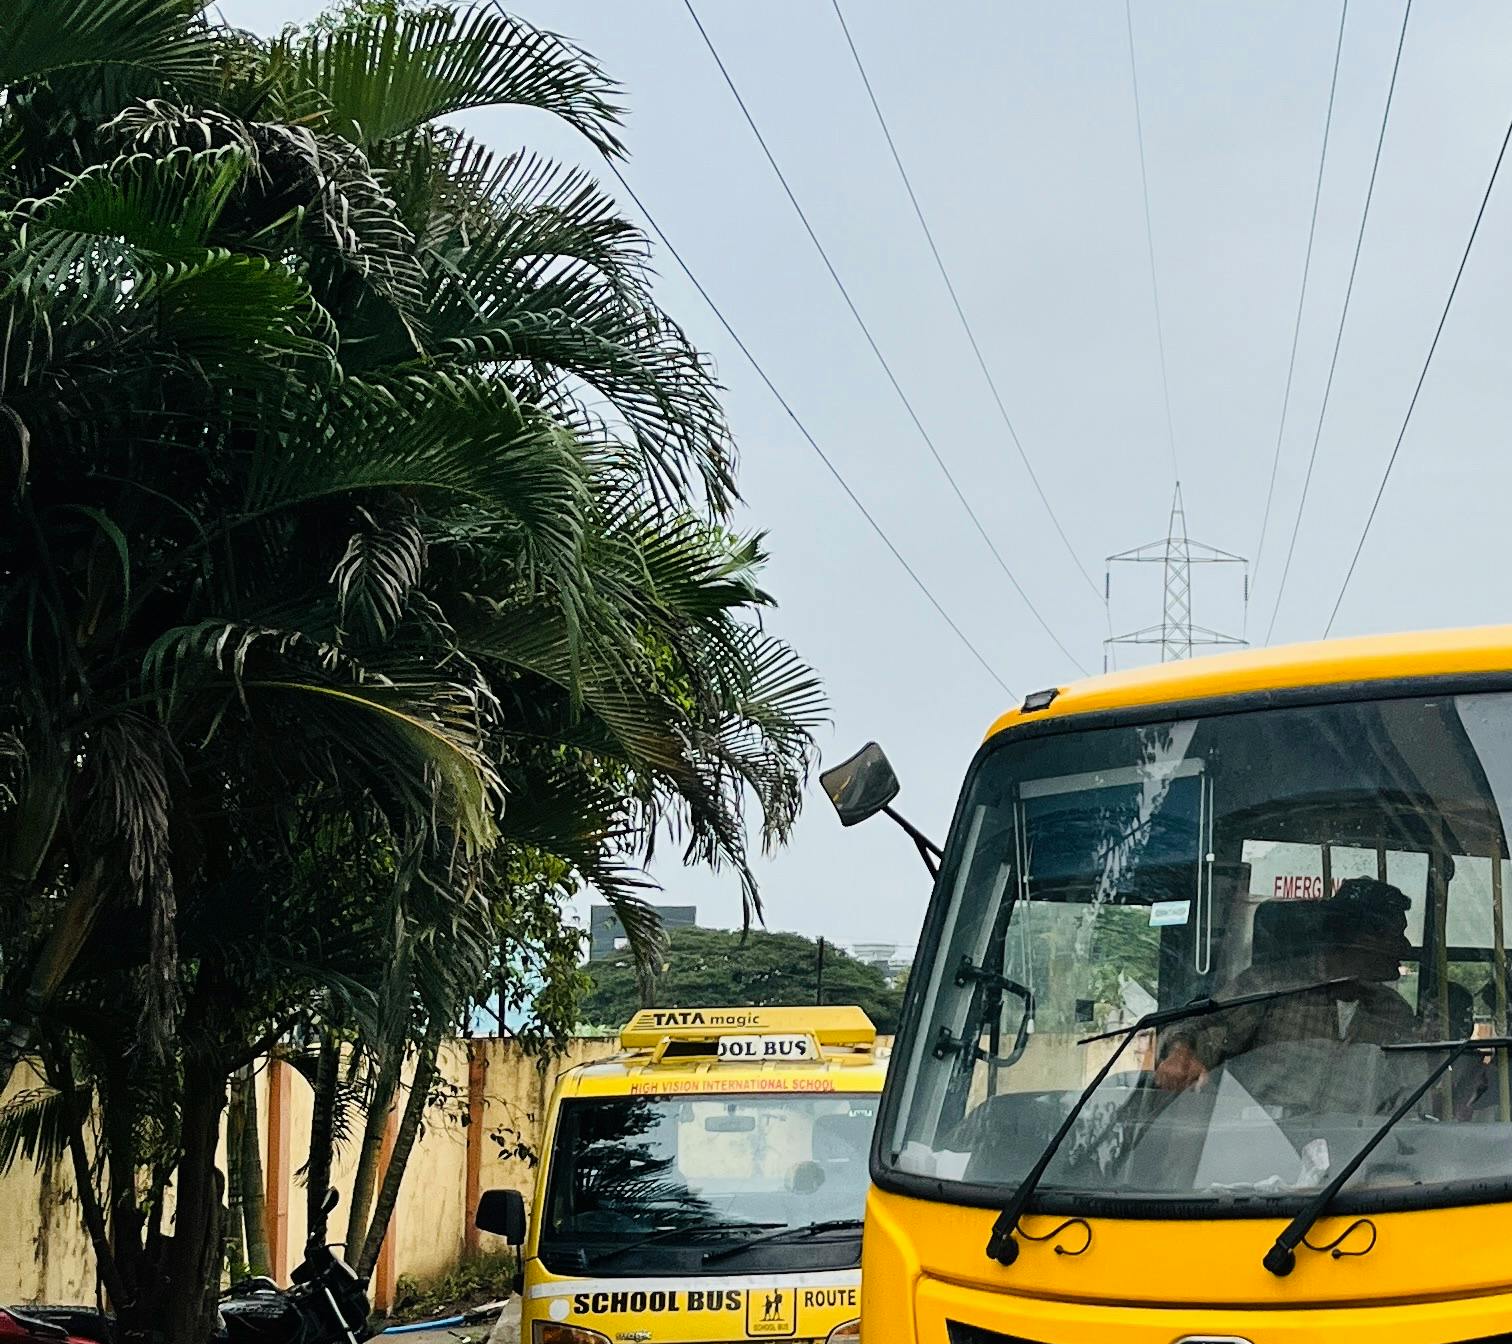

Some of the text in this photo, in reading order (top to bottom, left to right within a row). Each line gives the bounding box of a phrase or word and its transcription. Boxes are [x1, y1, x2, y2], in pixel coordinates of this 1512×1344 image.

[653, 1012, 760, 1027] TATA magic
[763, 1040, 806, 1056] BUS
[631, 1078, 835, 1094] HIGH VISION INTERNATIONAL SCHOOL
[574, 1290, 741, 1315] SCHOOL BUS
[804, 1289, 857, 1307] ROUTE
[753, 1323, 777, 1332] SCHOOL
